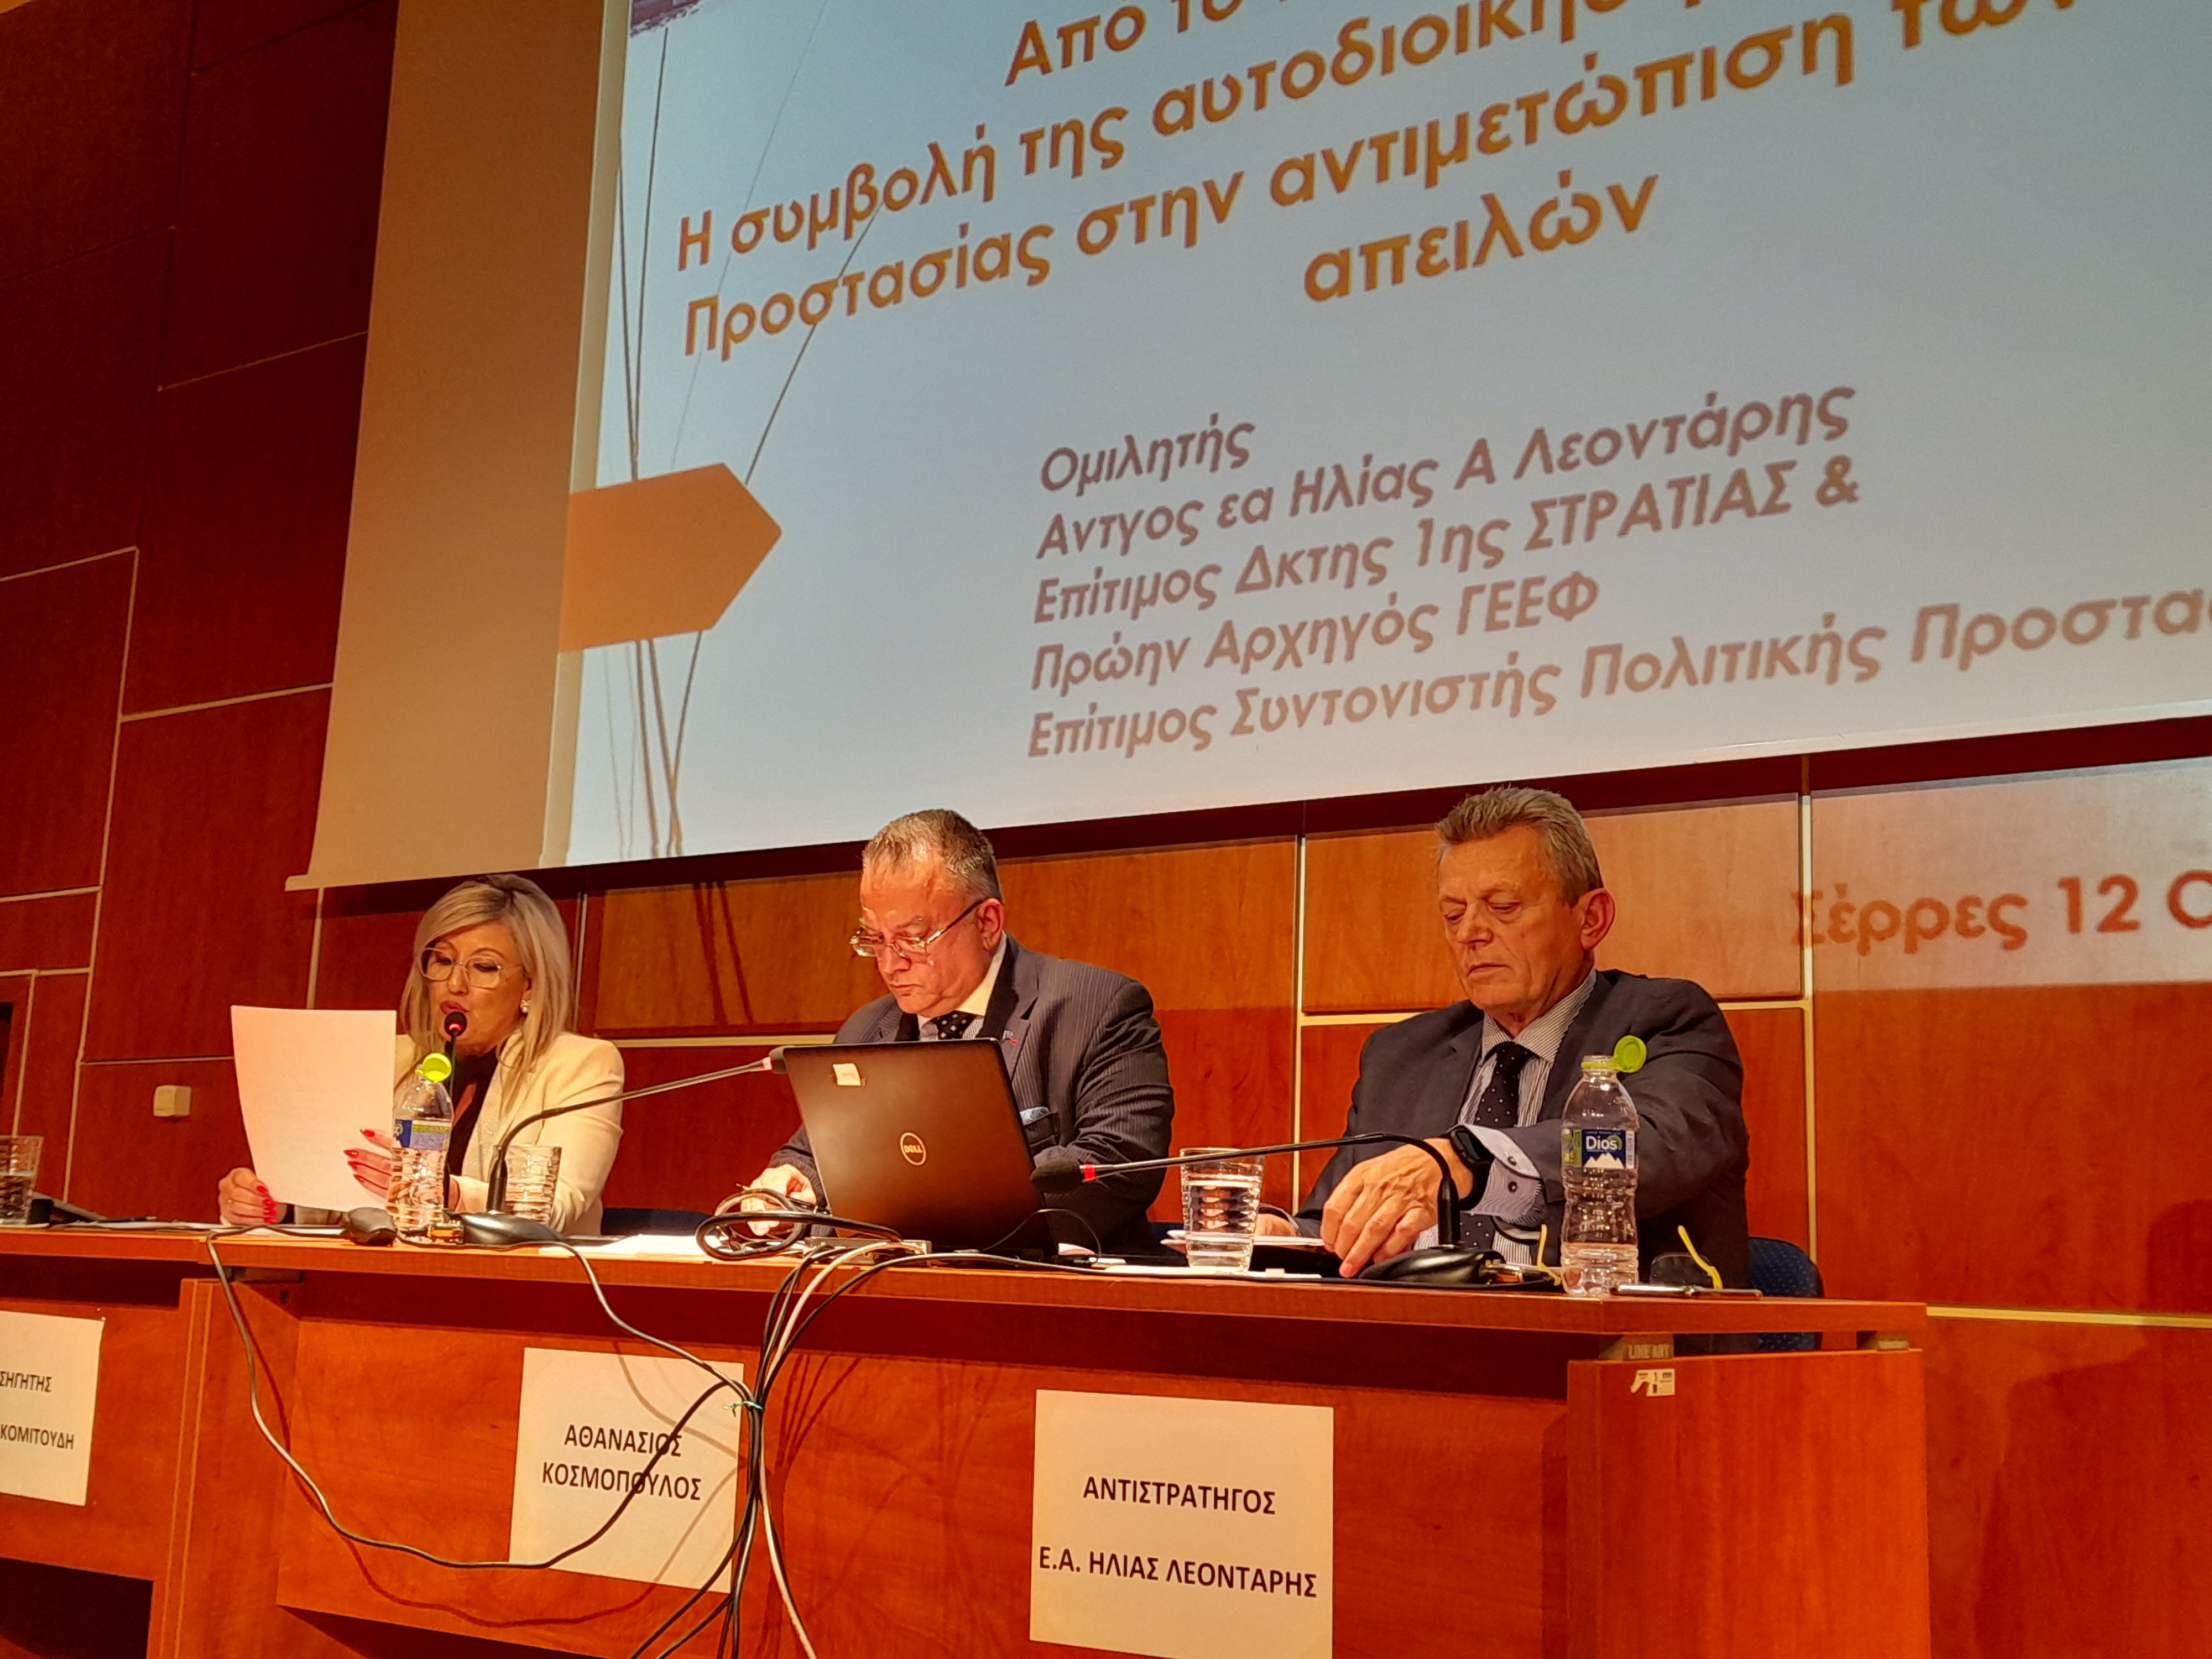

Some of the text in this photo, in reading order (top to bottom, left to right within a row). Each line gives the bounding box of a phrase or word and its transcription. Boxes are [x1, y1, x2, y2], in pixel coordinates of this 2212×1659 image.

[677, 209, 714, 272] Η
[730, 123, 997, 255] συμβολή
[1019, 105, 1130, 179] της
[684, 0, 2076, 362] Προστασίας στην αντιμετώπιση τω
[1303, 169, 1658, 304] απειλών
[1036, 387, 1856, 558] Αντγος εα Ηλίας Α Λεοντάρης
[1041, 413, 1255, 497] Ομιλητής
[1034, 455, 1859, 624] Επίτιμος Δκτης 1ης ΣΤΡΑΤΙΑΣ &
[1027, 588, 2212, 759] Επίτιμος Συντονιστής Πολιτικής Προστα
[1031, 571, 1599, 696] Πρώην Αρχηγός ΓΕΕΦ
[2057, 873, 2140, 934] 12
[1585, 1135, 1618, 1150] Dios
[0, 1423, 75, 1450] ΚΟΜΙΤΟΥΔΗ
[564, 1423, 682, 1457] ΑΘΑΝΑΣΙΟΣ
[542, 1461, 702, 1501] ΚΟΣΜΟΠΟΥΛΟΣ
[1082, 1476, 1276, 1515] ΑΝΤΙΣΤΡΑΤΗΓΟΣ
[1039, 1546, 1318, 1598] Ε.Α. ΗΛΙΑΣ ΛΕΟΝΤΑΡΗΣ
